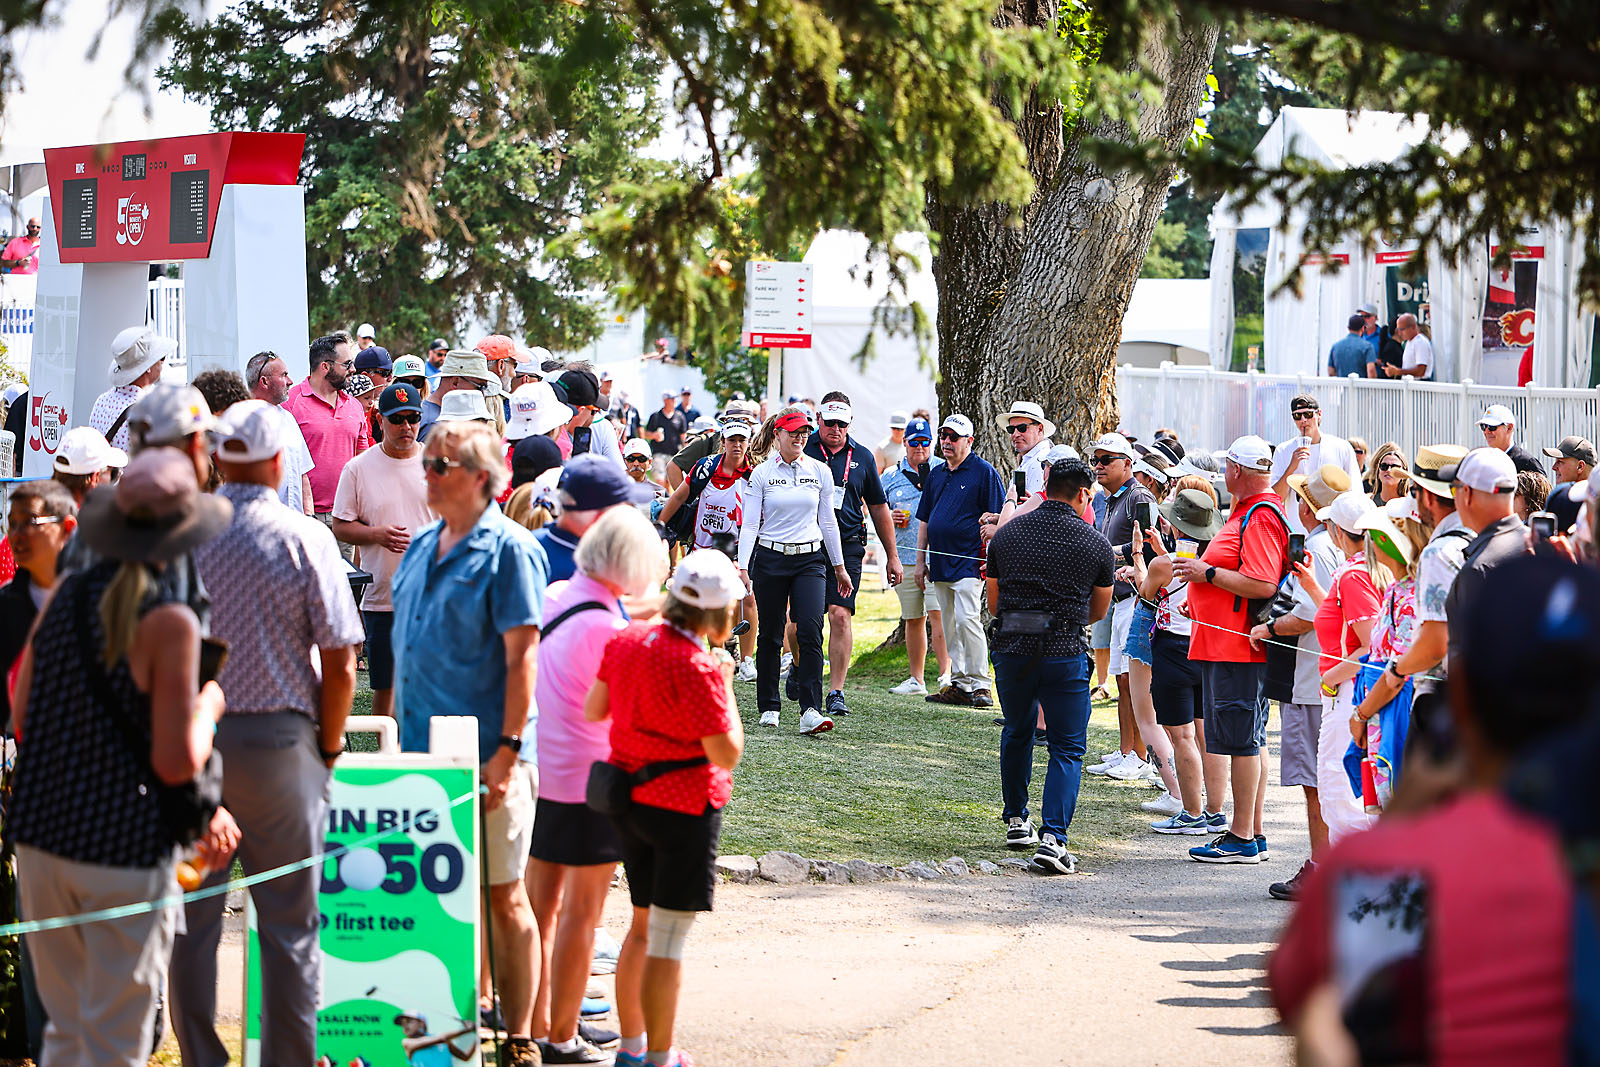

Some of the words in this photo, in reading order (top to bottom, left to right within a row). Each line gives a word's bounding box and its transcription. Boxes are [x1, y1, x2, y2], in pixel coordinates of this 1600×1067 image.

[129, 203, 142, 212] CPKC
[129, 222, 142, 234] OPEN
[1397, 282, 1430, 302] Dri
[43, 404, 58, 415] CPKC
[519, 401, 537, 410] BDO
[43, 427, 58, 441] OPEN
[768, 478, 787, 486] UKG
[702, 517, 724, 531] OPEN
[328, 808, 367, 834] IN
[376, 808, 440, 834] BIG
[335, 912, 375, 931] first
[380, 914, 416, 931] tee
